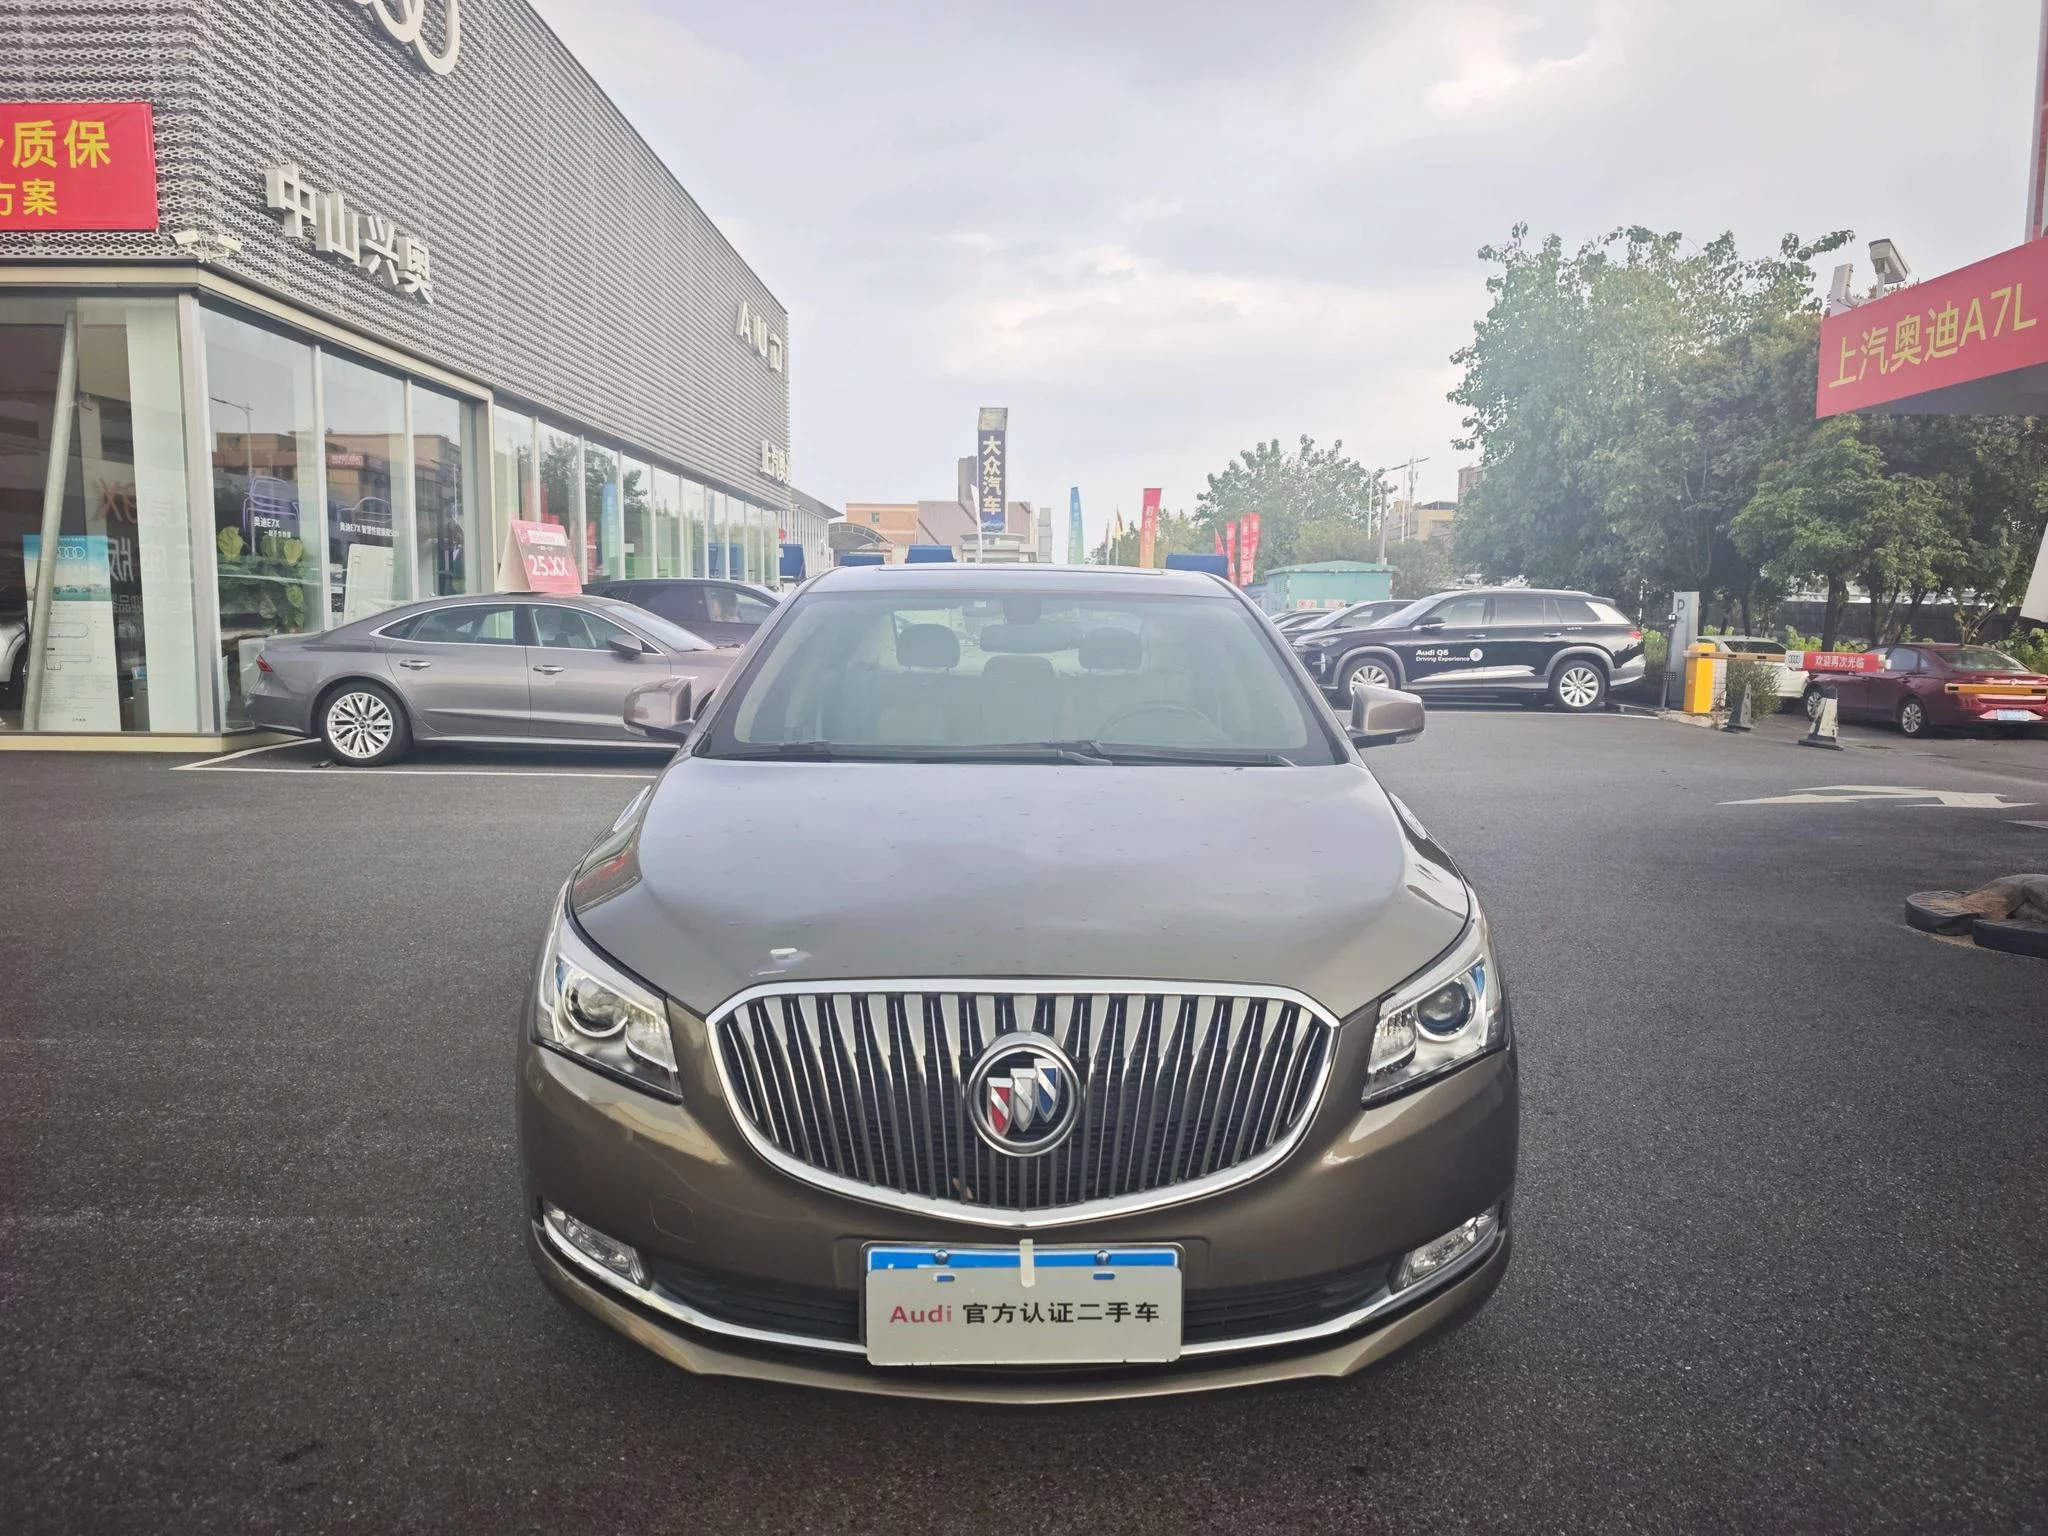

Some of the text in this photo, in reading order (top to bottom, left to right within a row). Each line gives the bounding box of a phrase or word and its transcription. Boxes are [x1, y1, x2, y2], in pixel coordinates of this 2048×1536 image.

[0, 120, 112, 168] 质保
[265, 163, 433, 304] 中山兴奥
[1828, 283, 2037, 389] 上汽奥迪A7L
[982, 435, 1002, 516] 大众汽车
[1815, 655, 1865, 669] 欢迎再次光临
[889, 1302, 1160, 1324] Audi 官方认证二手车
